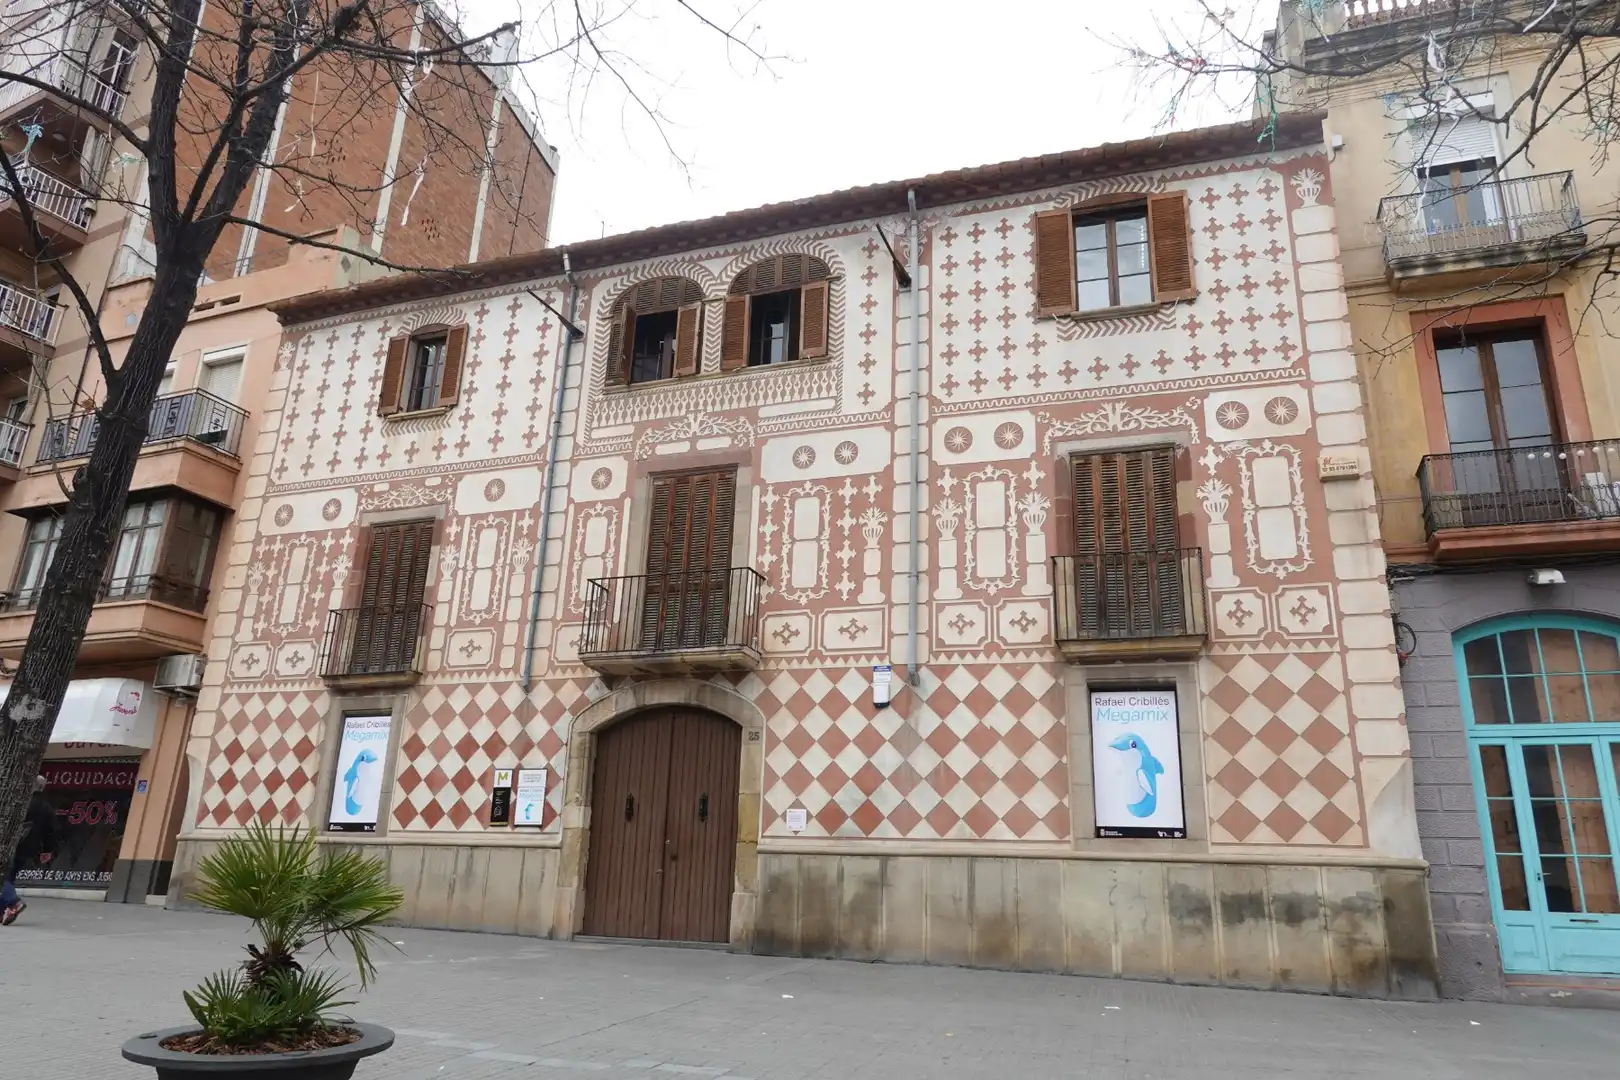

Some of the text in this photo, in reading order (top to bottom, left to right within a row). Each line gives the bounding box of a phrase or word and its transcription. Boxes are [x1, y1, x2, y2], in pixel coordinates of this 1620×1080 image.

[1095, 697, 1126, 707] Rafael
[1096, 707, 1169, 725] Megamix
[345, 730, 388, 743] Megamix
[748, 731, 760, 741] 25
[46, 771, 137, 786] LIQUIDACI
[56, 800, 118, 825] -50%
